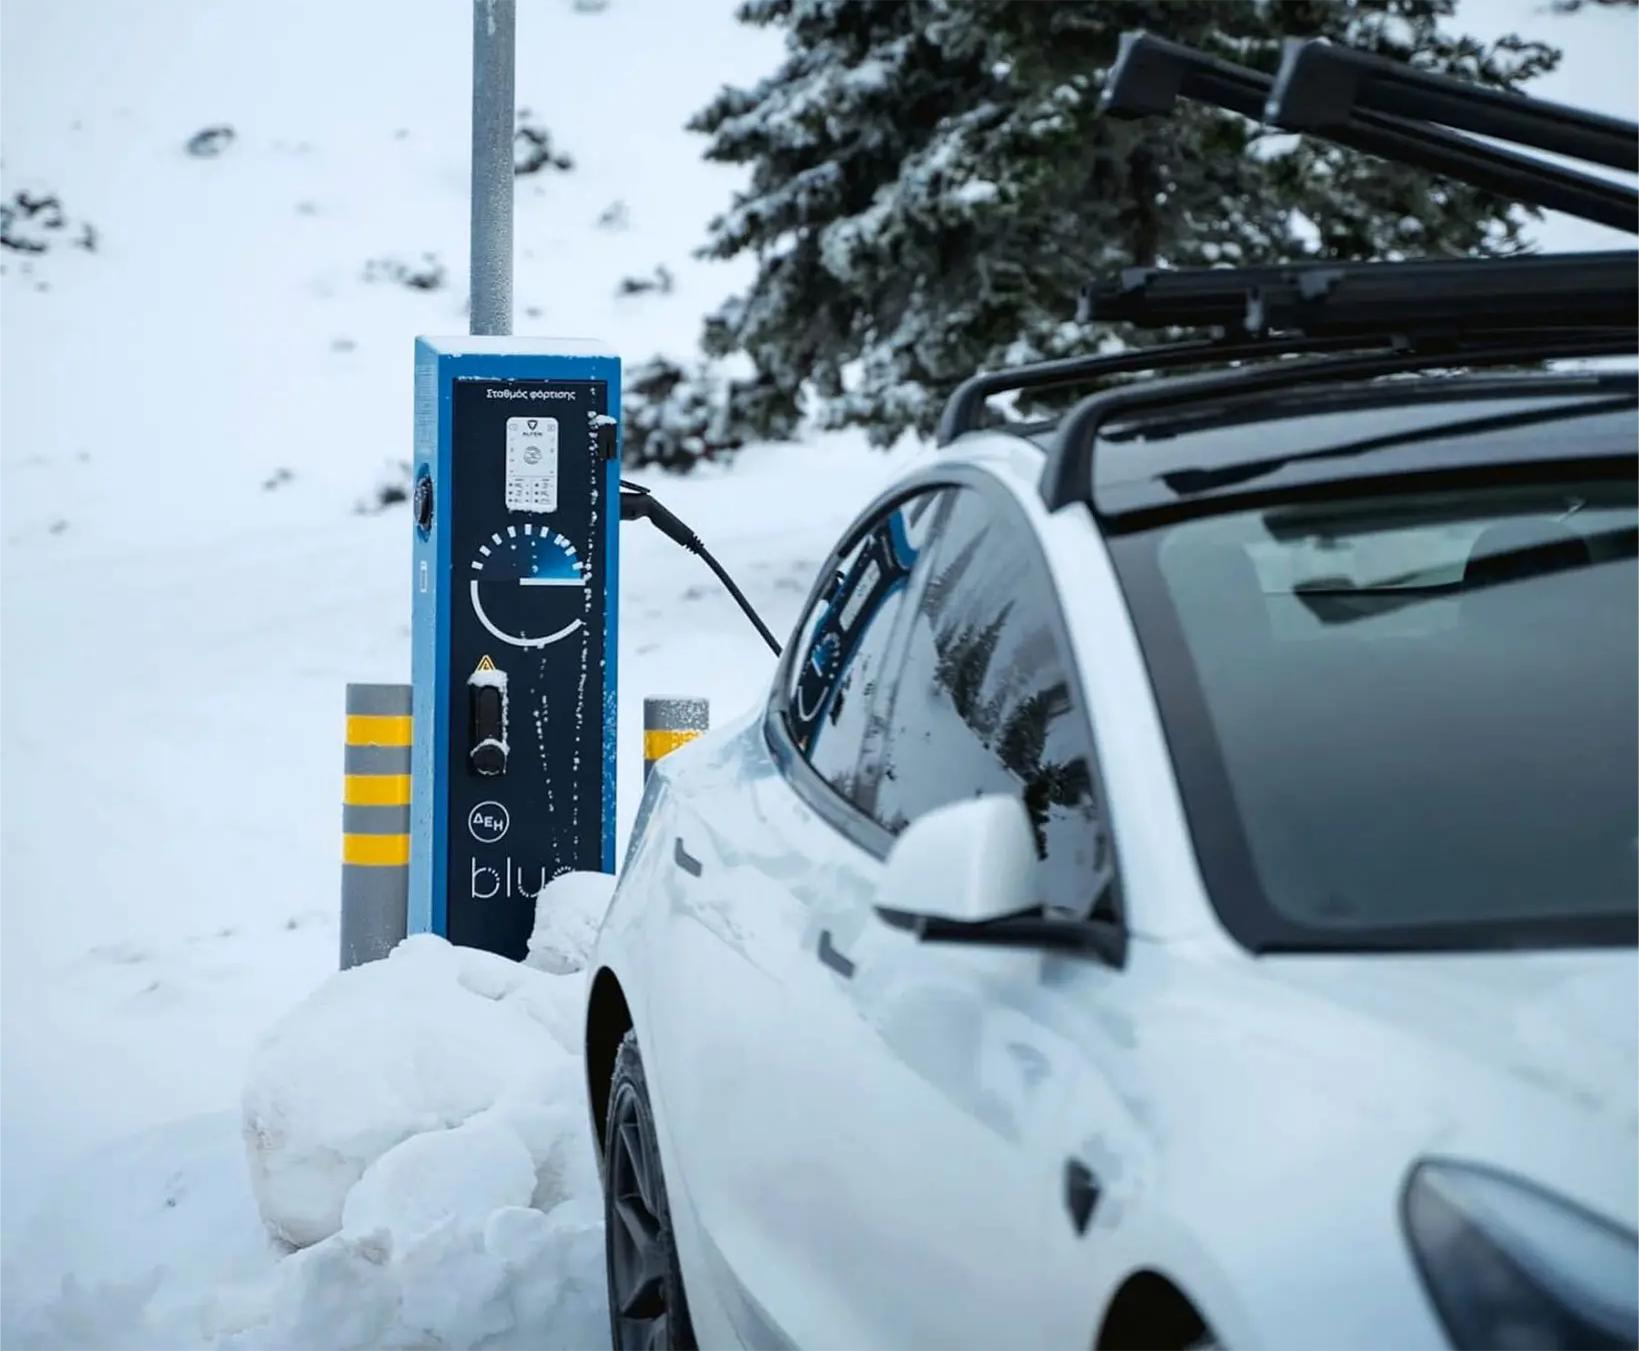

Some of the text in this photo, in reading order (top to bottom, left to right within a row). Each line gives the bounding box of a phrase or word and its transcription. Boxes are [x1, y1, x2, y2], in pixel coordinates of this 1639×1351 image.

[486, 388, 576, 401] Σταθμός φόρτισης
[471, 856, 576, 898] blu
